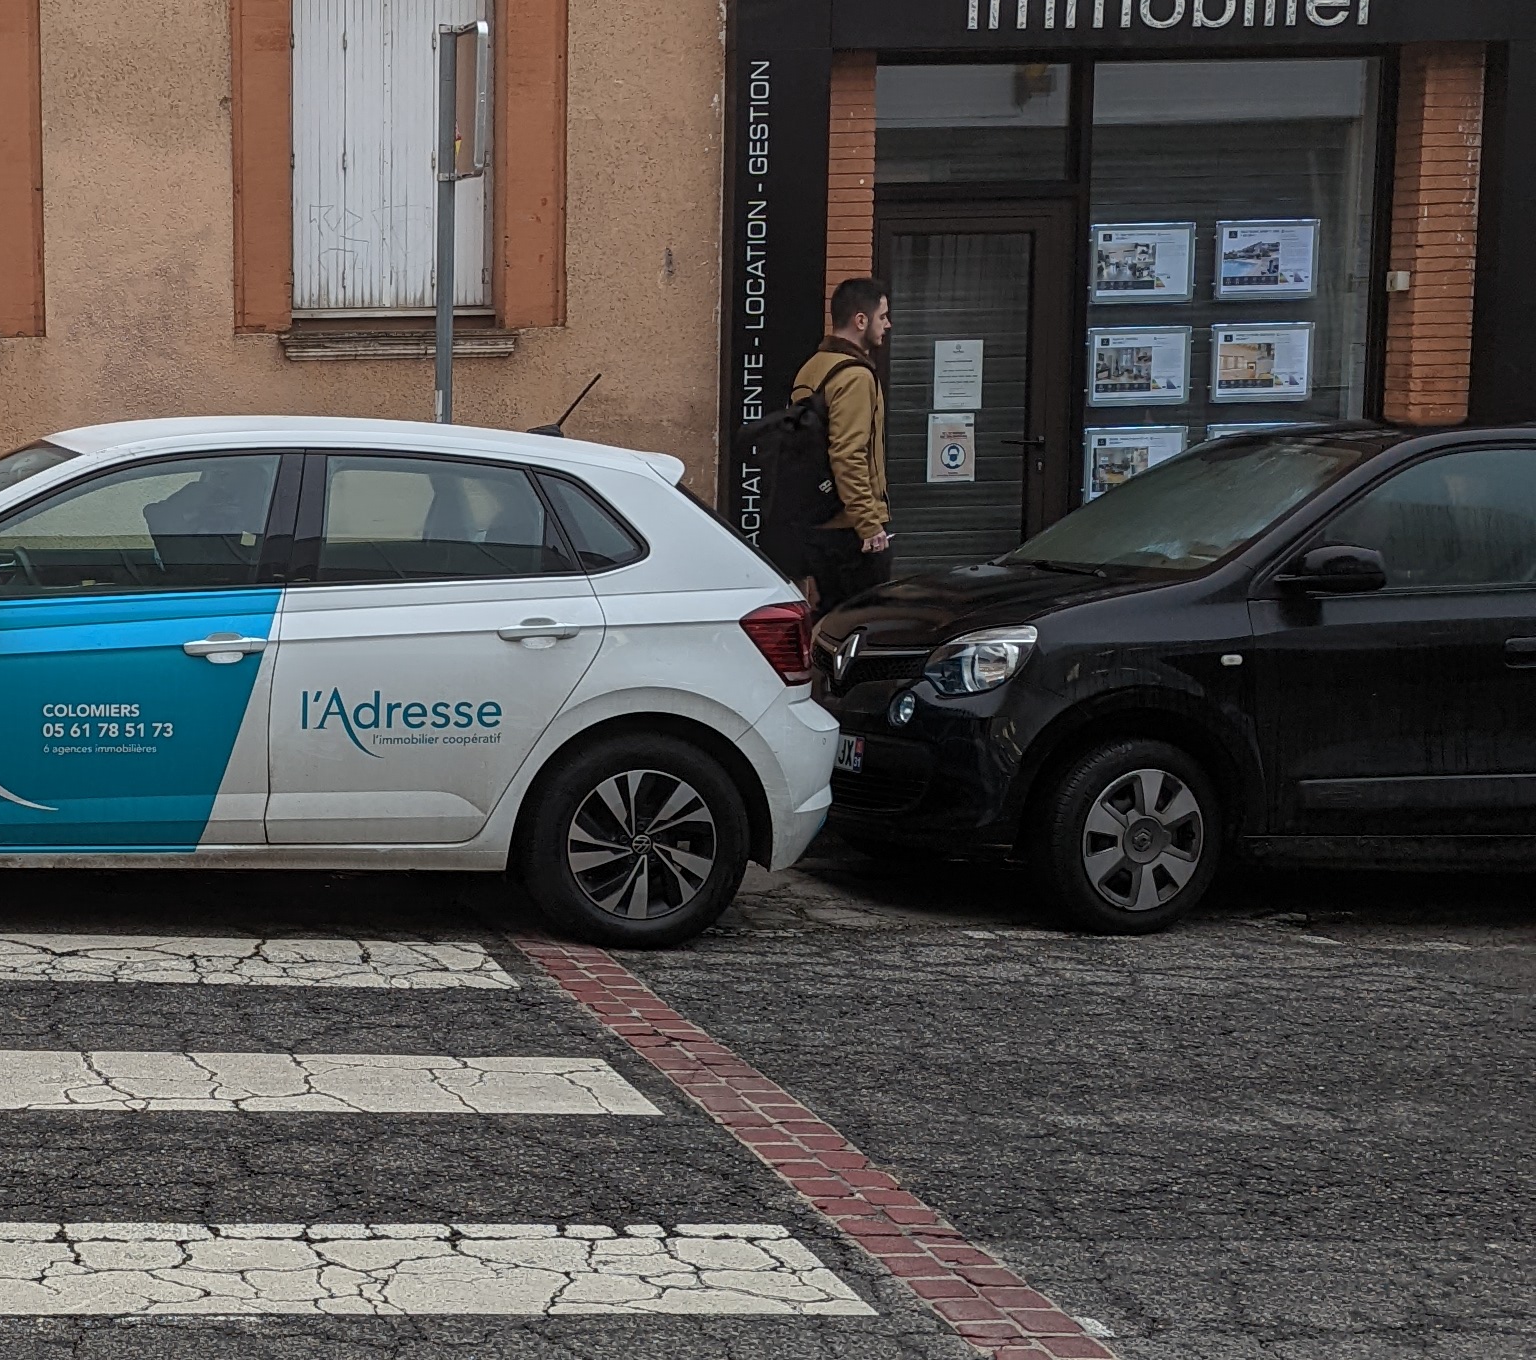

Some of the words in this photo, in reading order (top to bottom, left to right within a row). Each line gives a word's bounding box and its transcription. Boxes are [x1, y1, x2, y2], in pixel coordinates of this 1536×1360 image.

[748, 60, 771, 176] GESTION
[745, 200, 768, 330] LOCATION
[742, 353, 764, 425] ENTE
[741, 462, 762, 548] ACHAT
[42, 703, 140, 718] COLOMIERS
[42, 722, 65, 738] 05
[69, 722, 91, 738] 61
[97, 722, 119, 738] 78
[124, 722, 145, 738] 51
[151, 722, 174, 738] 73
[300, 686, 503, 759] l'Adresse
[372, 732, 439, 746] l'immobilier
[442, 732, 503, 747] coopératif
[43, 743, 50, 753] 6
[52, 745, 93, 756] agences
[94, 743, 157, 753] immobilières
